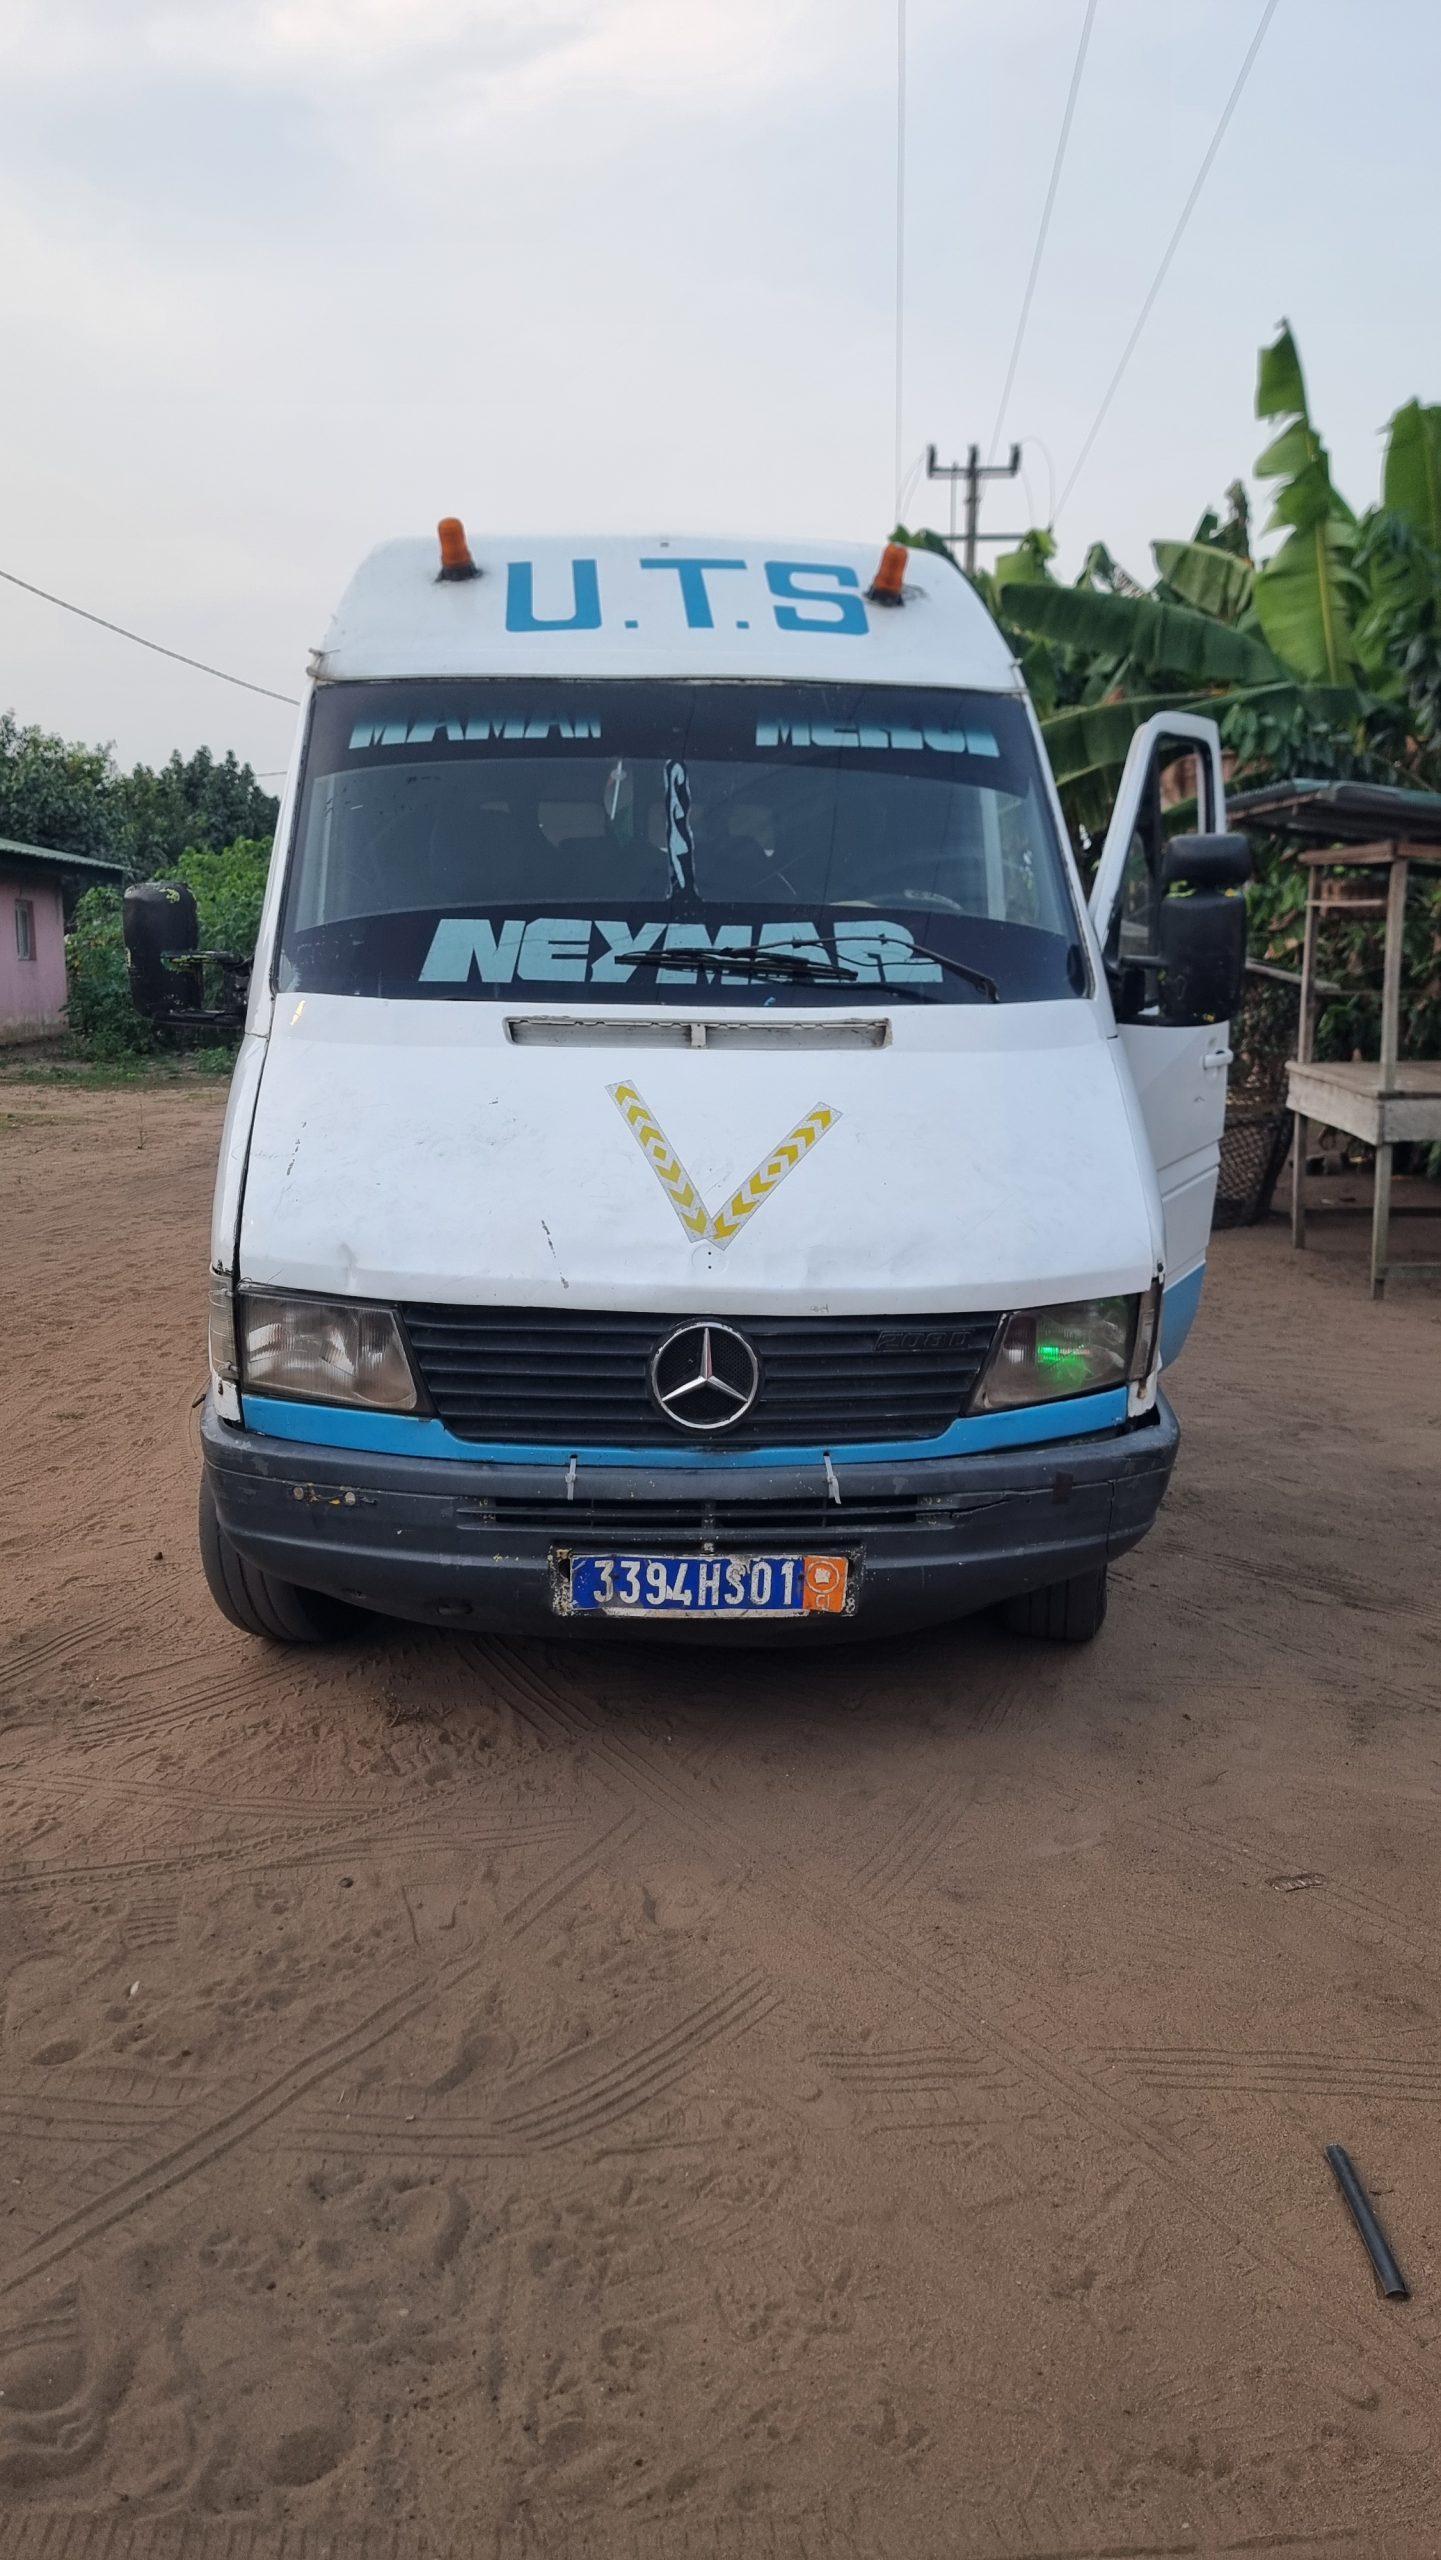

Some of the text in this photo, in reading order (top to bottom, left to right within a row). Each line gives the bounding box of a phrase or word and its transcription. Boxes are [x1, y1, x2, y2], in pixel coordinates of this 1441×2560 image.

[506, 558, 869, 635] U.T.S
[418, 918, 942, 983] NEYMAR
[593, 1560, 794, 1606] 3394HS01
